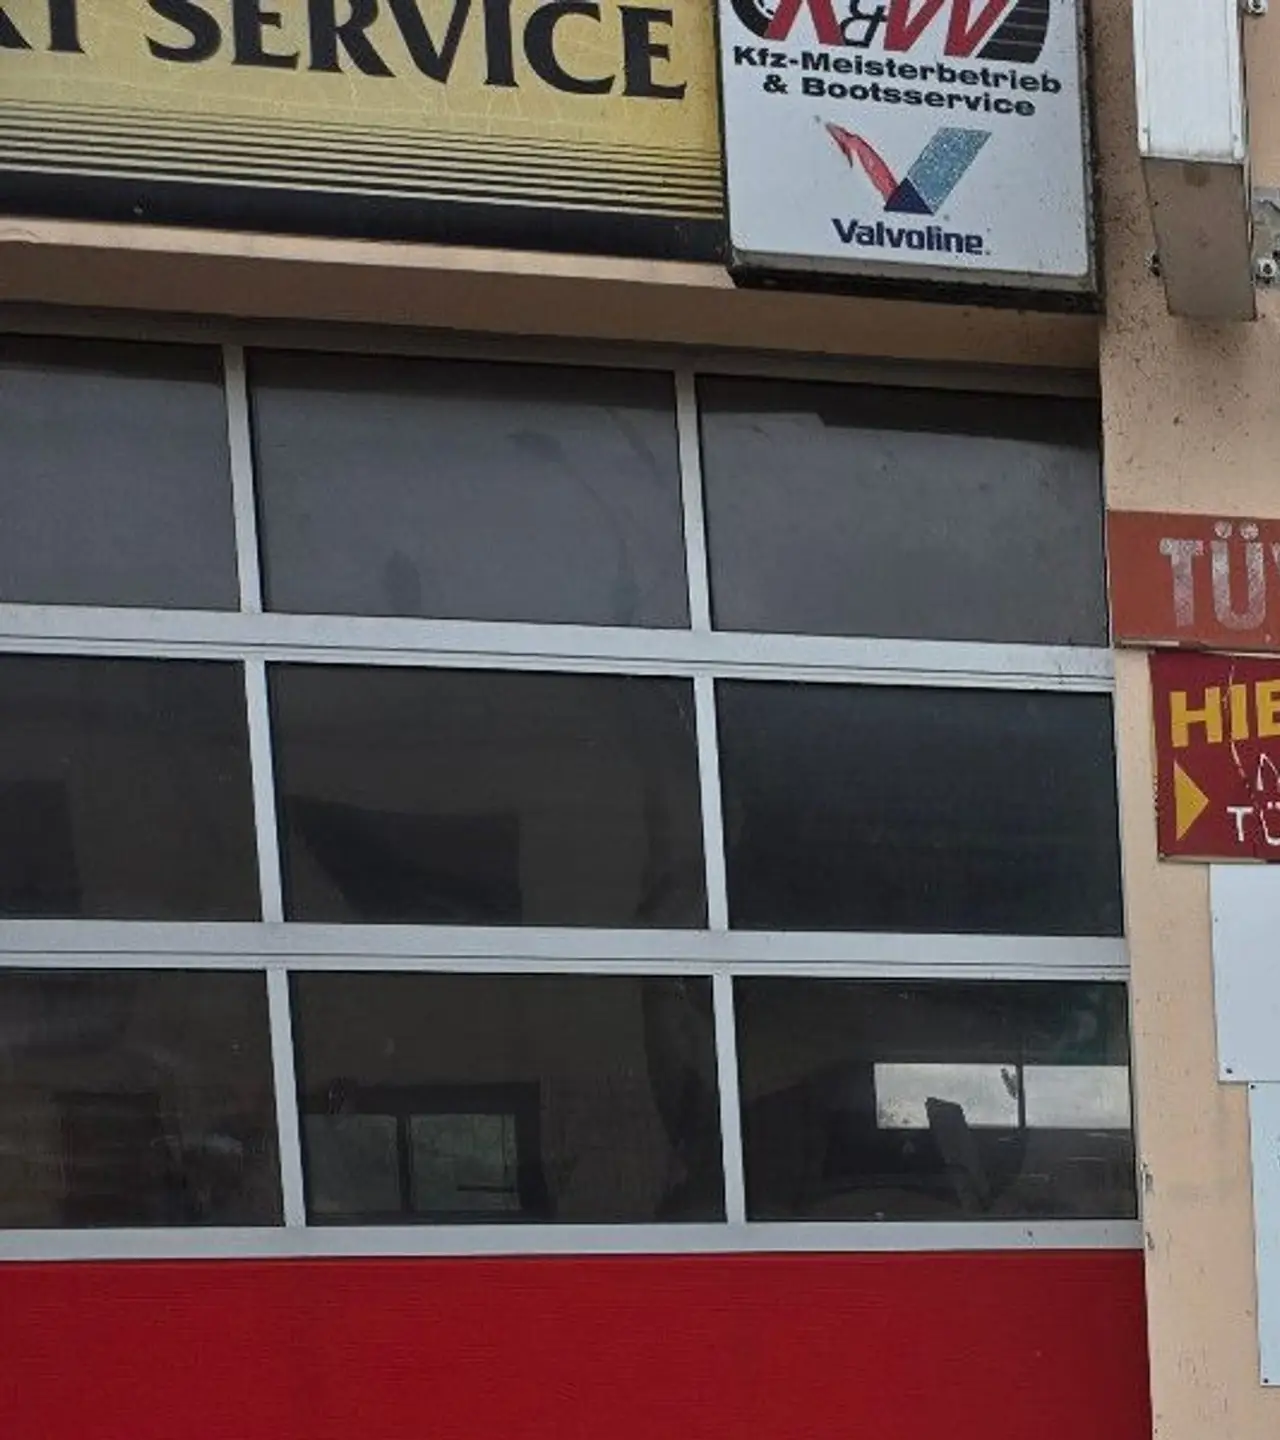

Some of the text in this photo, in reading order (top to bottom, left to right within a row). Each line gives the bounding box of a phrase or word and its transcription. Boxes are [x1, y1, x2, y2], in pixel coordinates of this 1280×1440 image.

[145, 0, 687, 99] SERVICE
[733, 45, 1062, 95] Kfz-Meisterbetrieb
[762, 74, 1036, 116] & Bootsservice
[832, 218, 985, 255] Valvoline
